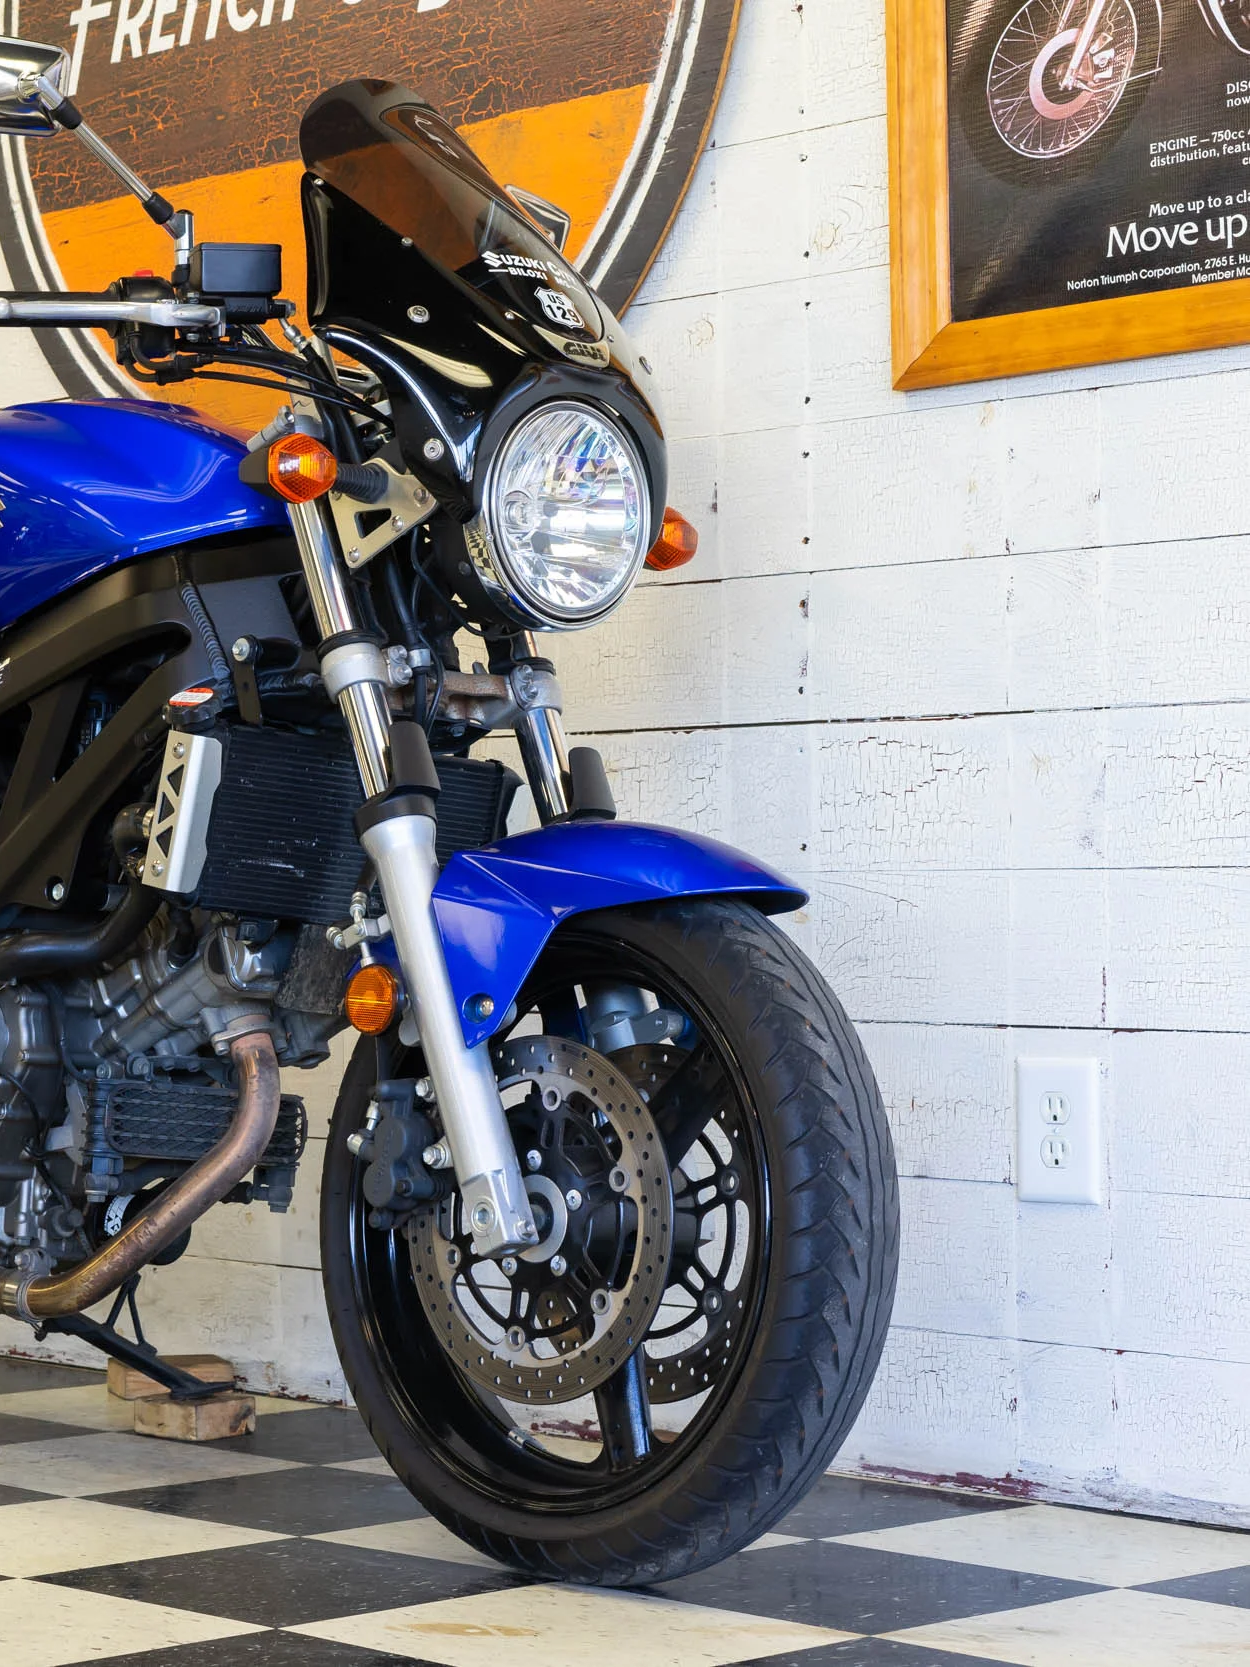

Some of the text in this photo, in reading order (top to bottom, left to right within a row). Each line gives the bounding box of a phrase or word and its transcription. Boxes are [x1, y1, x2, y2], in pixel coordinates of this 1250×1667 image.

[69, 0, 296, 96] FREN
[1227, 80, 1250, 94] DIS
[1150, 135, 1197, 154] ENGINE
[1211, 129, 1245, 143] 750cc
[1150, 148, 1220, 168] distribution,
[1148, 203, 1184, 218] Move
[1187, 199, 1205, 214] up
[1208, 195, 1222, 208] to
[1225, 195, 1233, 205] a
[1106, 213, 1248, 258] Move up
[481, 250, 548, 272] SUZUKI
[508, 266, 548, 281] BILOXI
[1067, 277, 1099, 291] Norton
[1100, 270, 1138, 285] Triumph
[1139, 261, 1203, 280] Corporation,
[1204, 255, 1227, 269] 2765
[1229, 255, 1237, 265] E.
[1191, 268, 1235, 284] Member
[547, 294, 565, 305] US
[546, 304, 580, 323] 129
